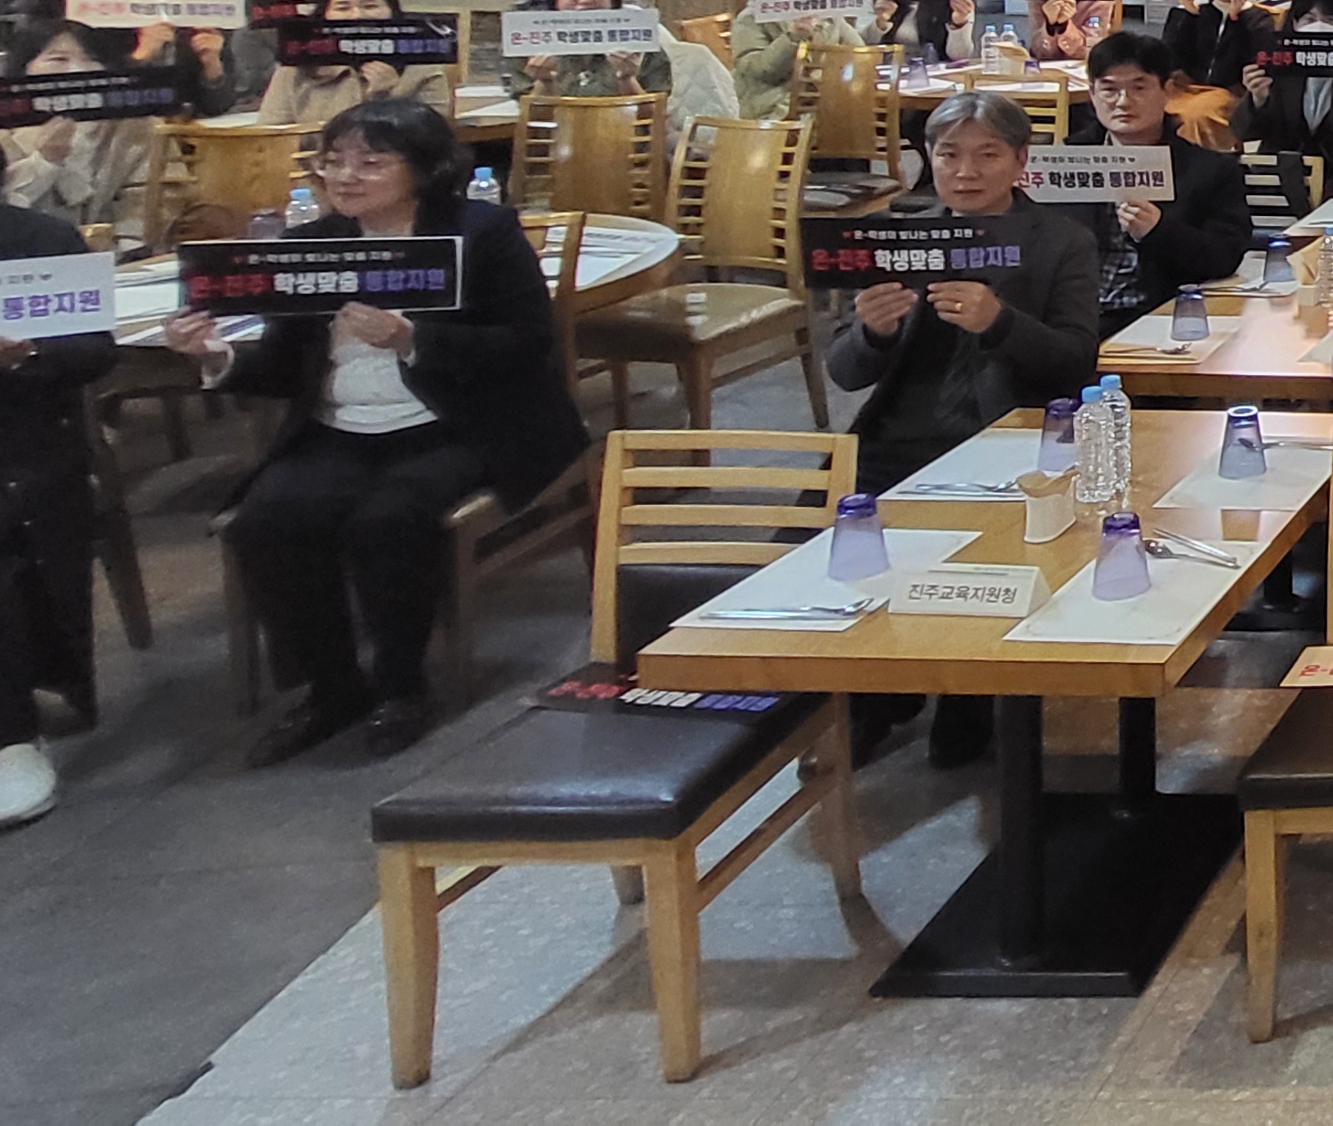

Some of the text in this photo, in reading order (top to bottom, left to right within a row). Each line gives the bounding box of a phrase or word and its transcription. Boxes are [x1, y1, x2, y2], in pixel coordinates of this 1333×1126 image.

[1020, 171, 1044, 188] 진주
[812, 245, 1020, 272] 온-진주 학생맞춤 통합지원
[190, 268, 444, 298] 온-진주 학생맞춤 통합지원
[3, 289, 100, 320] 통합지원
[908, 583, 1018, 605] 진주교육지원청
